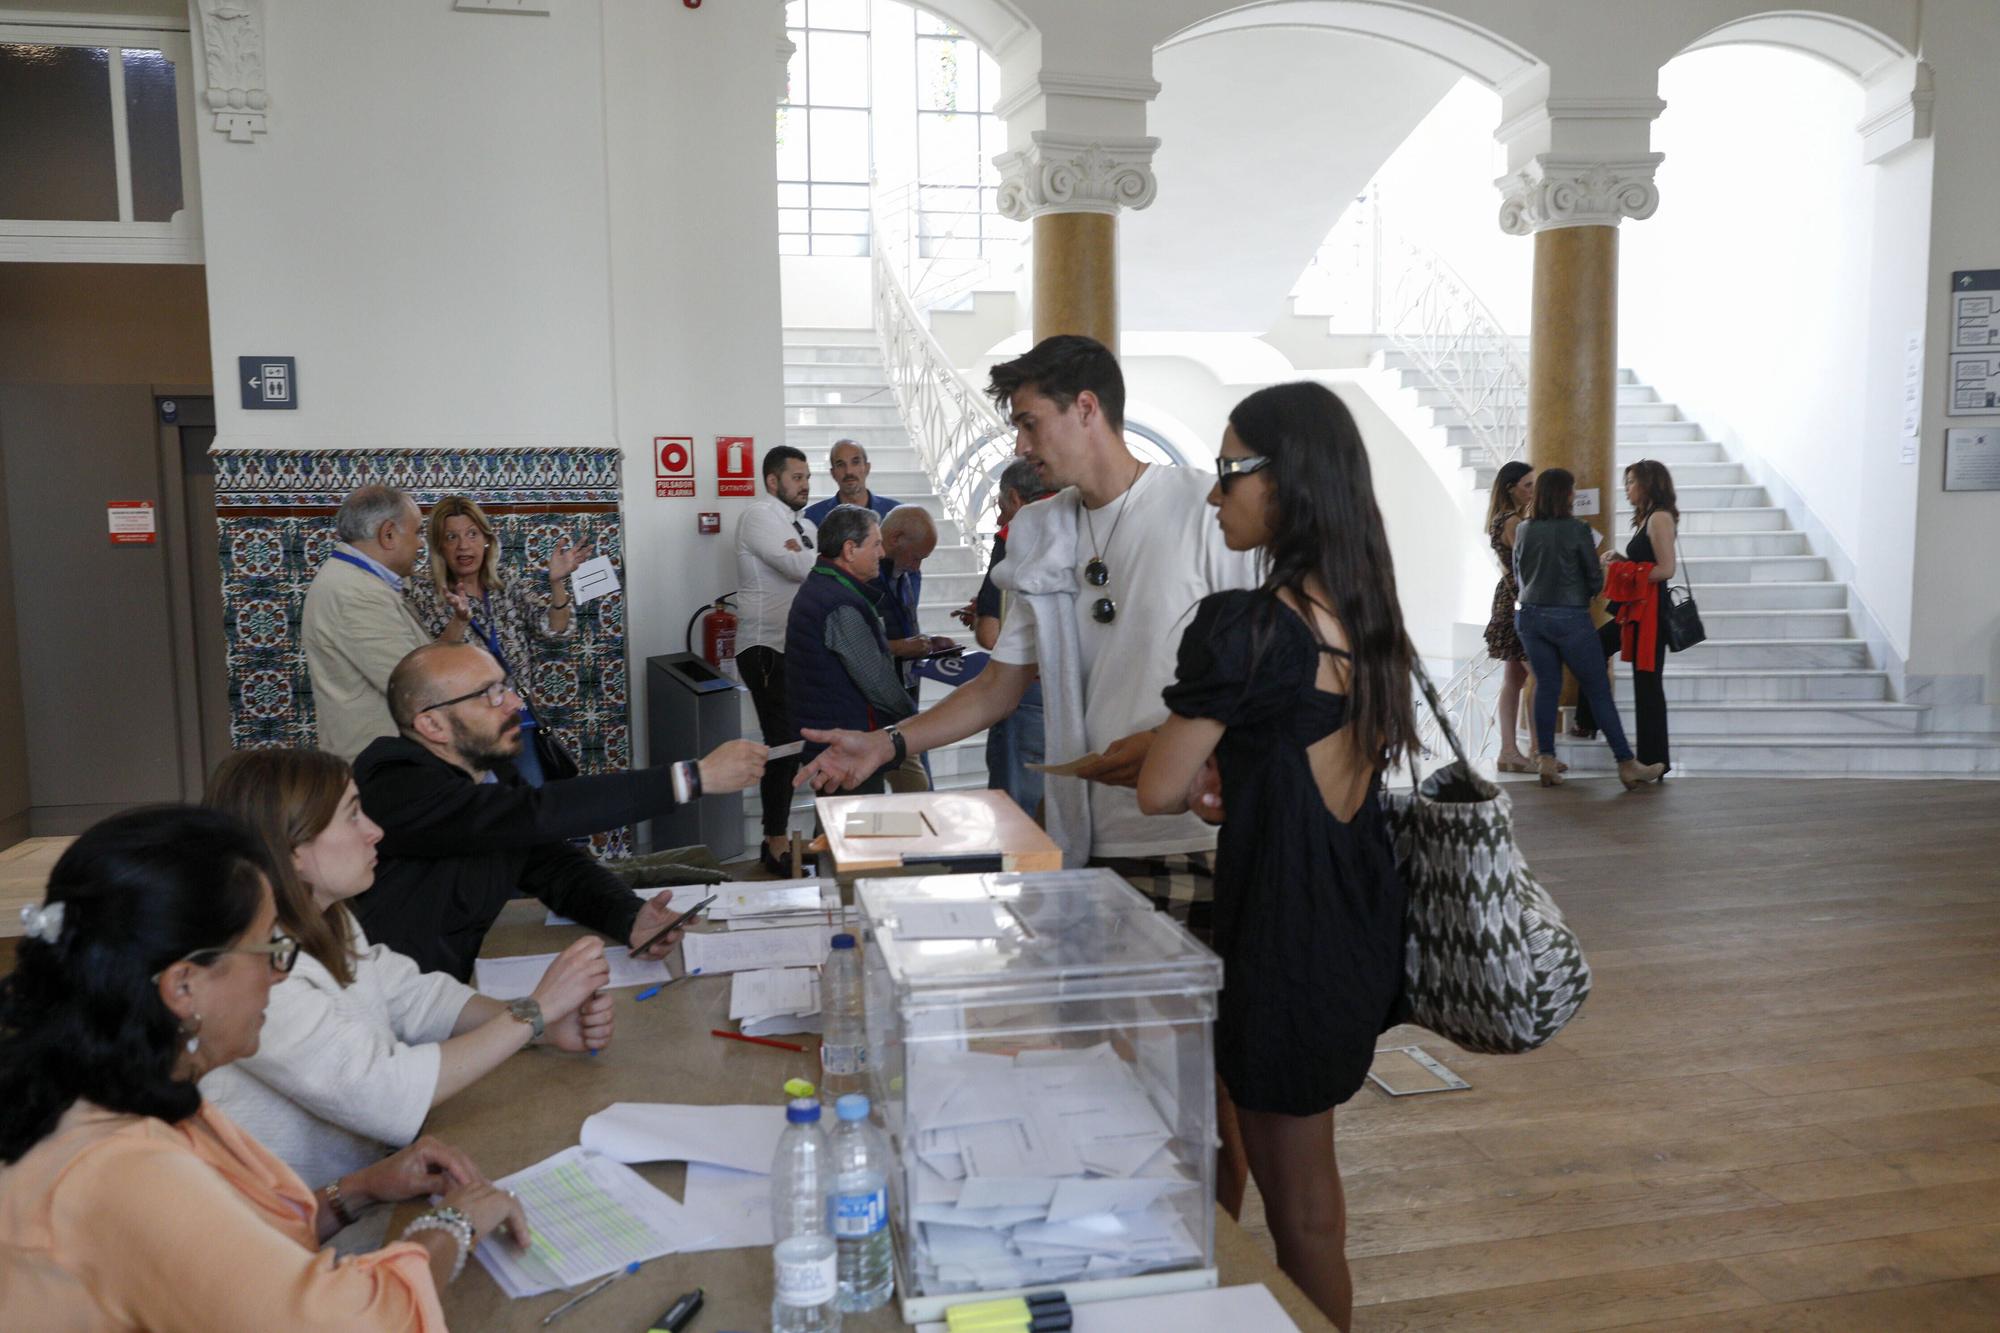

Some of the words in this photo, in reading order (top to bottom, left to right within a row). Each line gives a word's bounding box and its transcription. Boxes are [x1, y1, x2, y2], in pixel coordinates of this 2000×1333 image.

[657, 481, 693, 489] PULSADOR
[720, 484, 753, 492] EXTINTOR
[658, 489, 667, 497] DE
[668, 489, 694, 497] ALARMA
